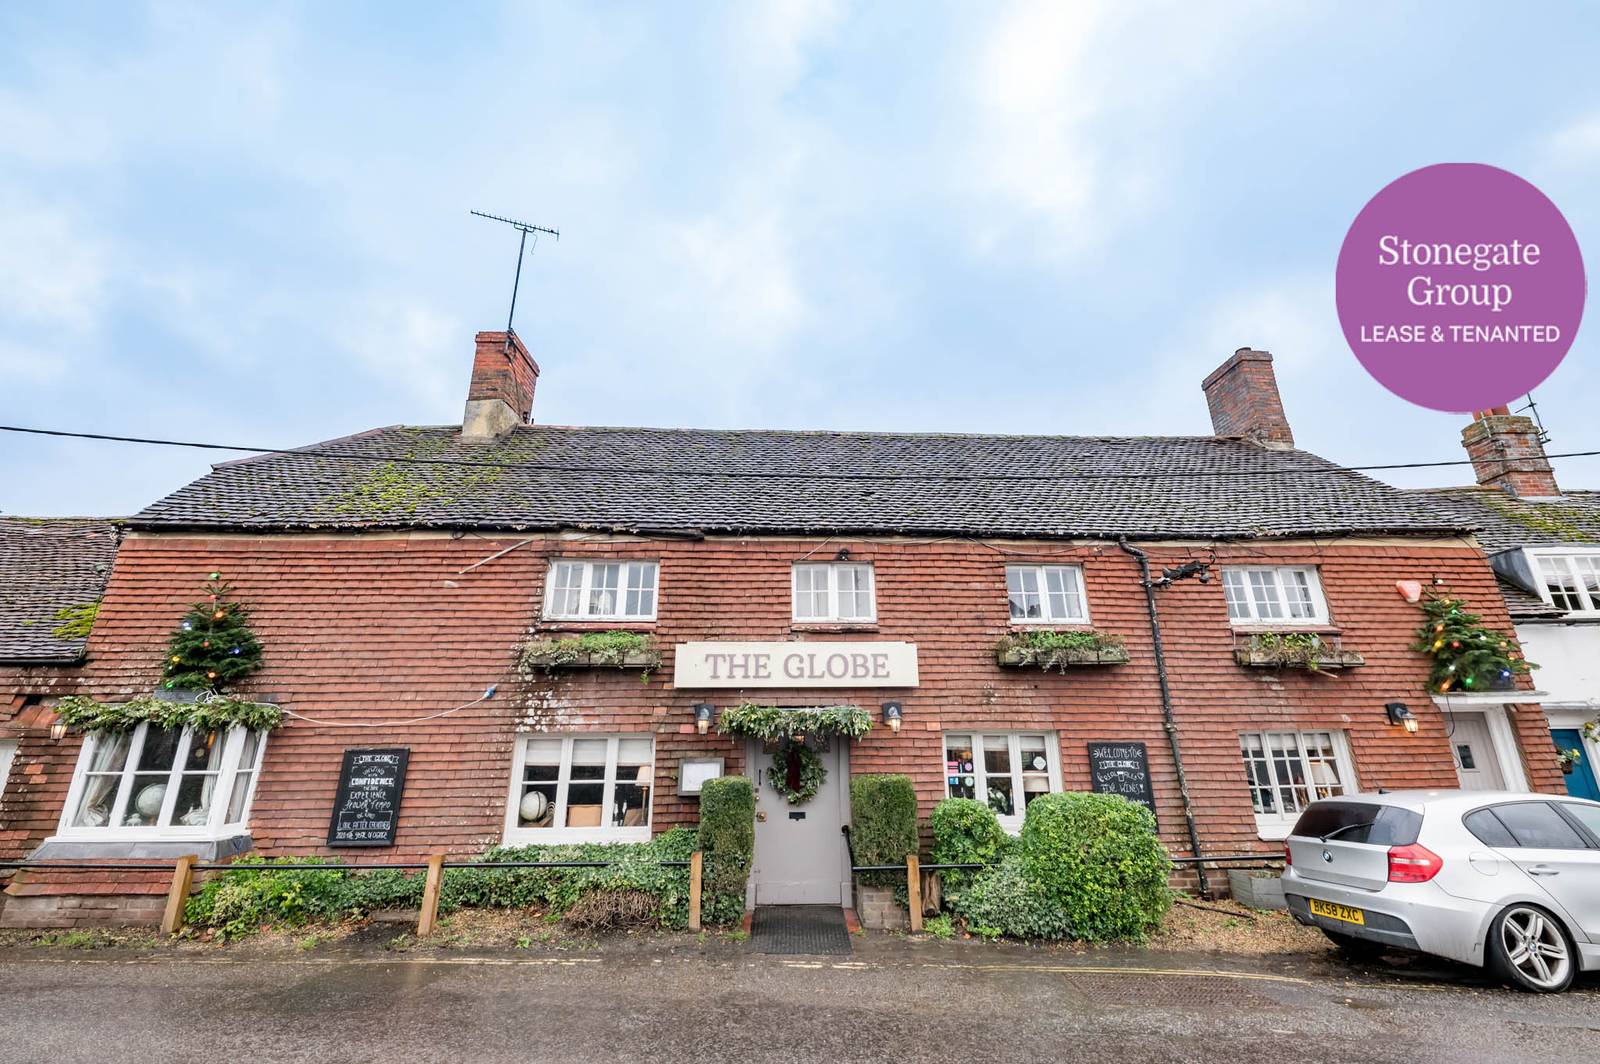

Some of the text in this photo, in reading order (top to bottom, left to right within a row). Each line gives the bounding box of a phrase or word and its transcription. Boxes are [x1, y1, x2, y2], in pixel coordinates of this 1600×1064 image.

[705, 653, 890, 680] THE GLOBE
[1098, 747, 1130, 759] WELCOME
[351, 777, 394, 786] CONFIDENCE
[1313, 901, 1359, 921] BK58 ZXC
